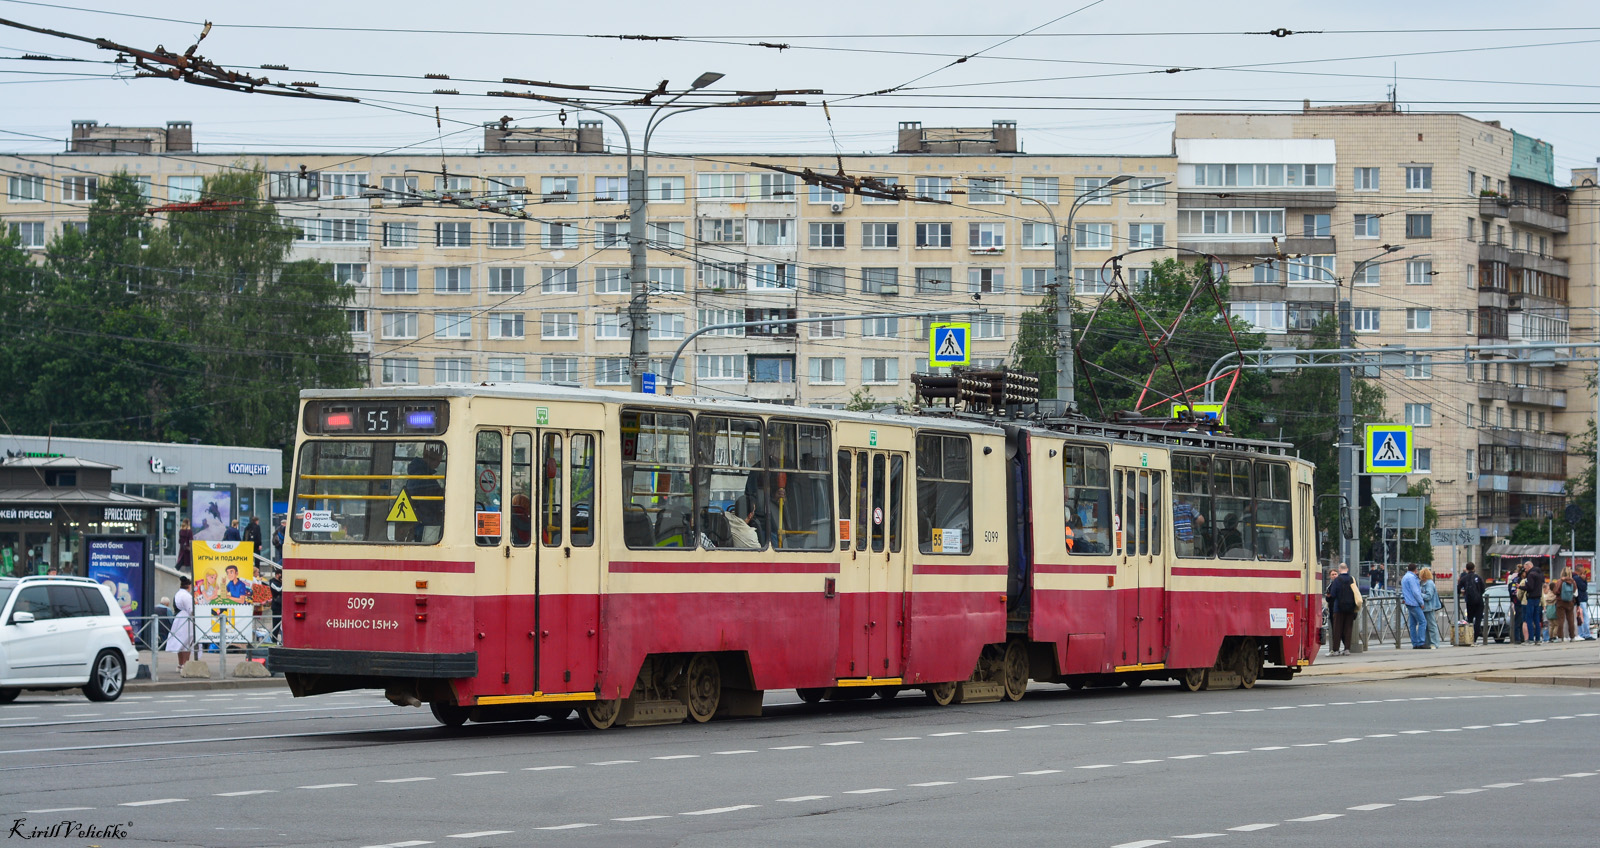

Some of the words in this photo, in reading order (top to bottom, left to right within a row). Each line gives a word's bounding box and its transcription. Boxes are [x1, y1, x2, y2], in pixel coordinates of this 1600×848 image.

[367, 410, 389, 431] 55
[151, 456, 163, 473] t2
[230, 463, 270, 476] КОПИЦЕНТР
[18, 510, 52, 519] ПРЕССЫ
[108, 508, 123, 520] PRICE
[124, 509, 142, 521] COFFEE
[933, 534, 942, 546] 55
[984, 531, 998, 542] 5099
[347, 597, 375, 610] 5099
[333, 619, 370, 629] ВЫНОС
